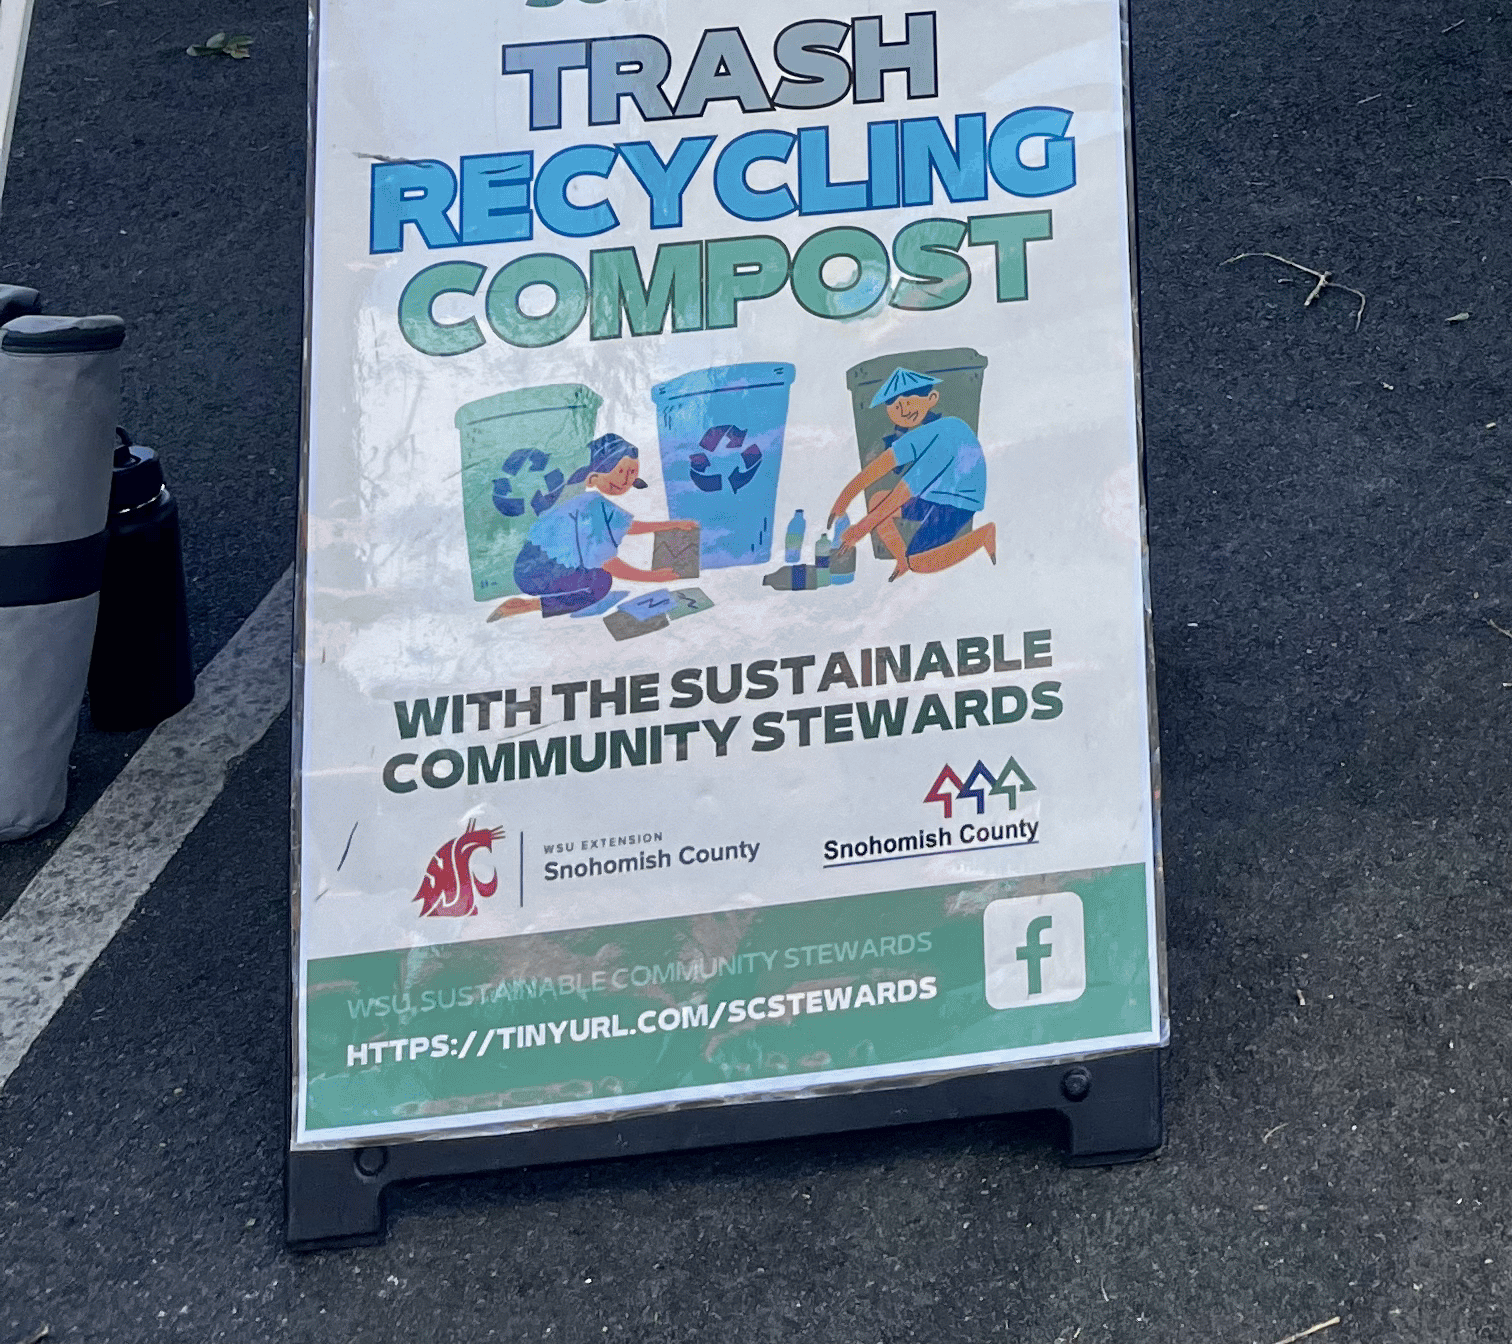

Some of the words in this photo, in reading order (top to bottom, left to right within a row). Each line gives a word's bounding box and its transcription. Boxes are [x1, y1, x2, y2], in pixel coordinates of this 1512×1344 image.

[501, 10, 939, 131] TRASH
[369, 106, 1077, 255] RECYCLING
[397, 210, 1053, 358] COMPOST
[393, 685, 542, 740] WITH
[551, 671, 660, 719] THE
[668, 628, 1053, 709] SUSTAINABLE
[382, 715, 741, 795] COMMUNITY
[750, 680, 1064, 754] STEWARDS
[543, 841, 576, 855] WSU
[580, 830, 663, 851] EXTENSION
[544, 848, 671, 882] Snohomish
[678, 837, 761, 868] County
[822, 827, 952, 862] Snohomish
[958, 818, 1039, 846] County
[346, 975, 938, 1068] HTTPS://TINYURL.COM/SCSTEWARDS
[420, 970, 607, 1012] SUSTAINABLE
[611, 949, 778, 990] COMMUNITY
[784, 931, 933, 969] STEWARDS
